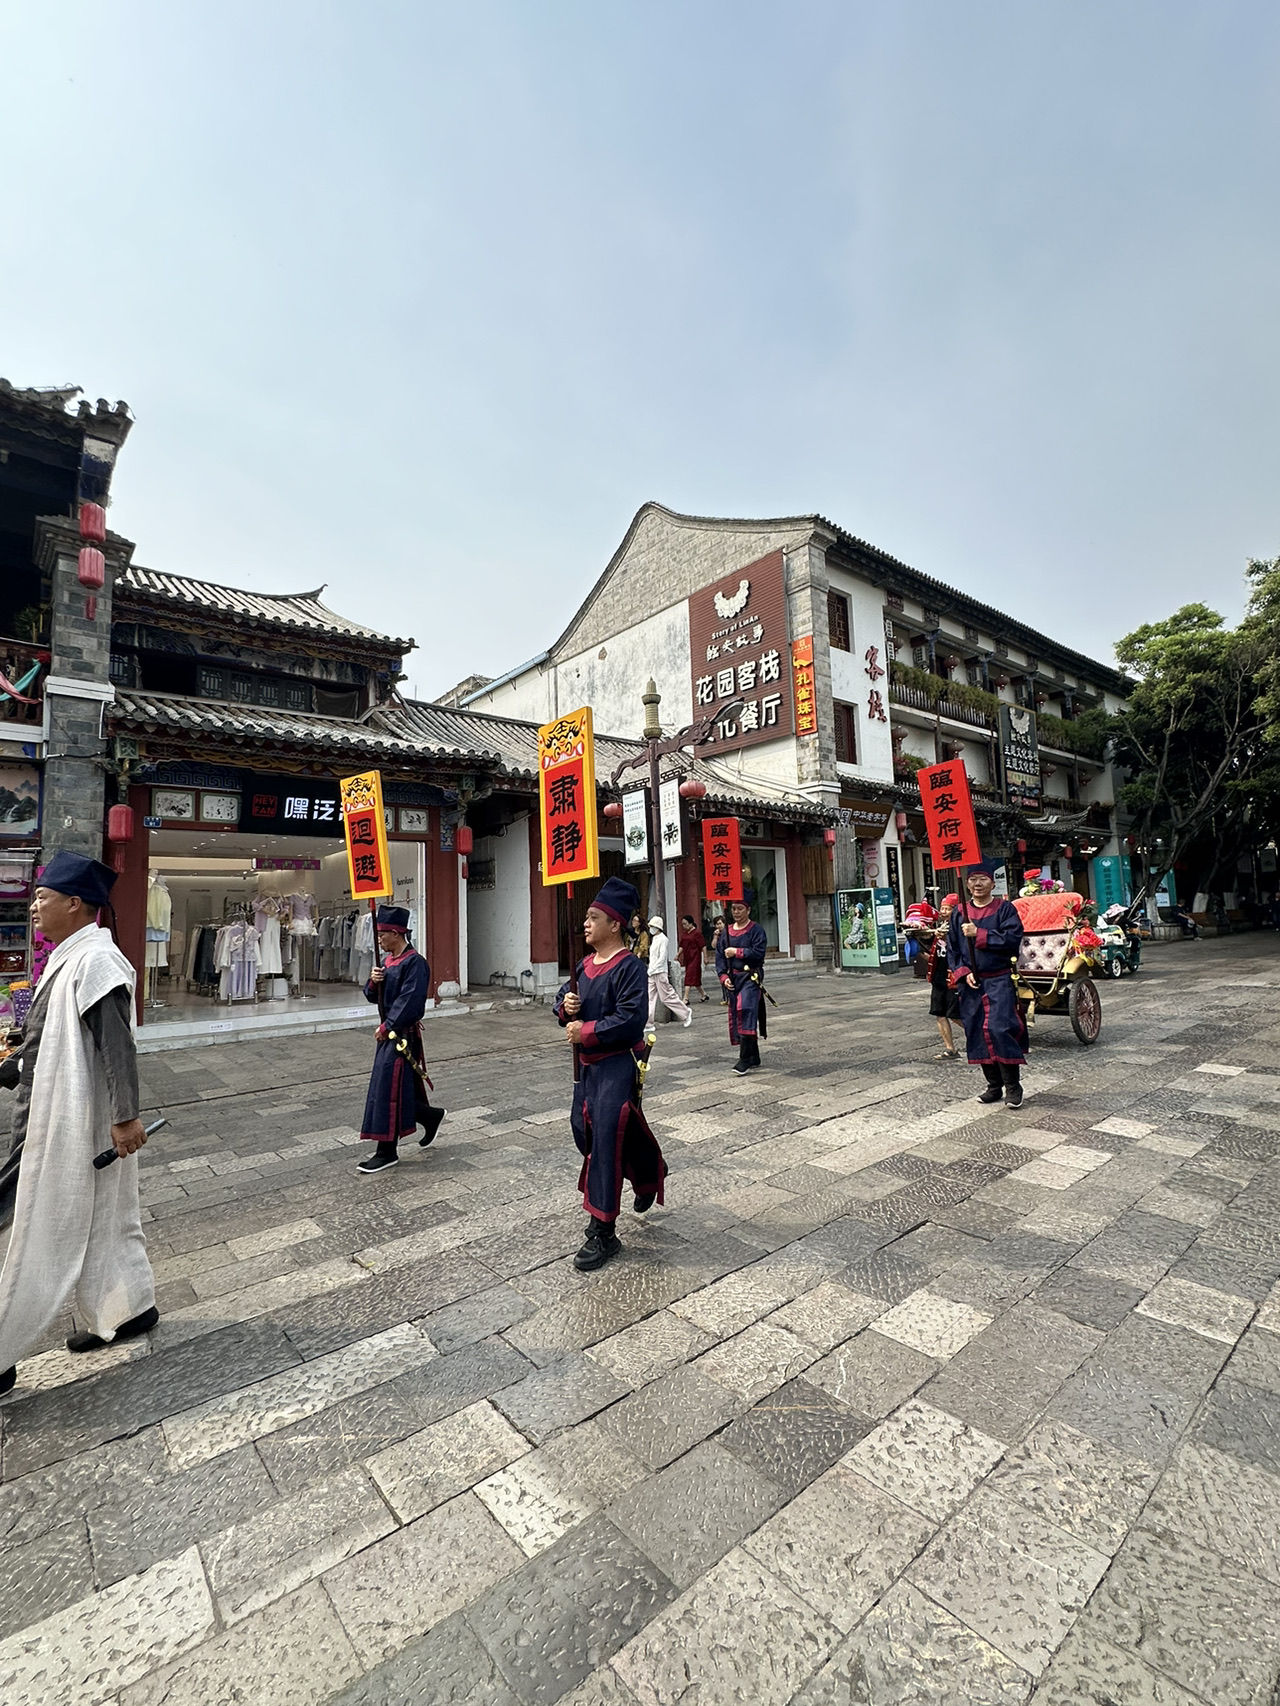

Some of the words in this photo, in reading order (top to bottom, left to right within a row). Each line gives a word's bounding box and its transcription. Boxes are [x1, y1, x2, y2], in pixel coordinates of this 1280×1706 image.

[696, 649, 780, 705] 花园客栈
[796, 672, 812, 731] 孔雀珠宝
[701, 692, 781, 743] 化餐厅
[254, 806, 275, 815] FAN
[255, 797, 275, 806] HEY
[284, 796, 343, 821] 嘿泛
[929, 769, 966, 863] 臨安府署
[710, 823, 733, 897] 臨安府署
